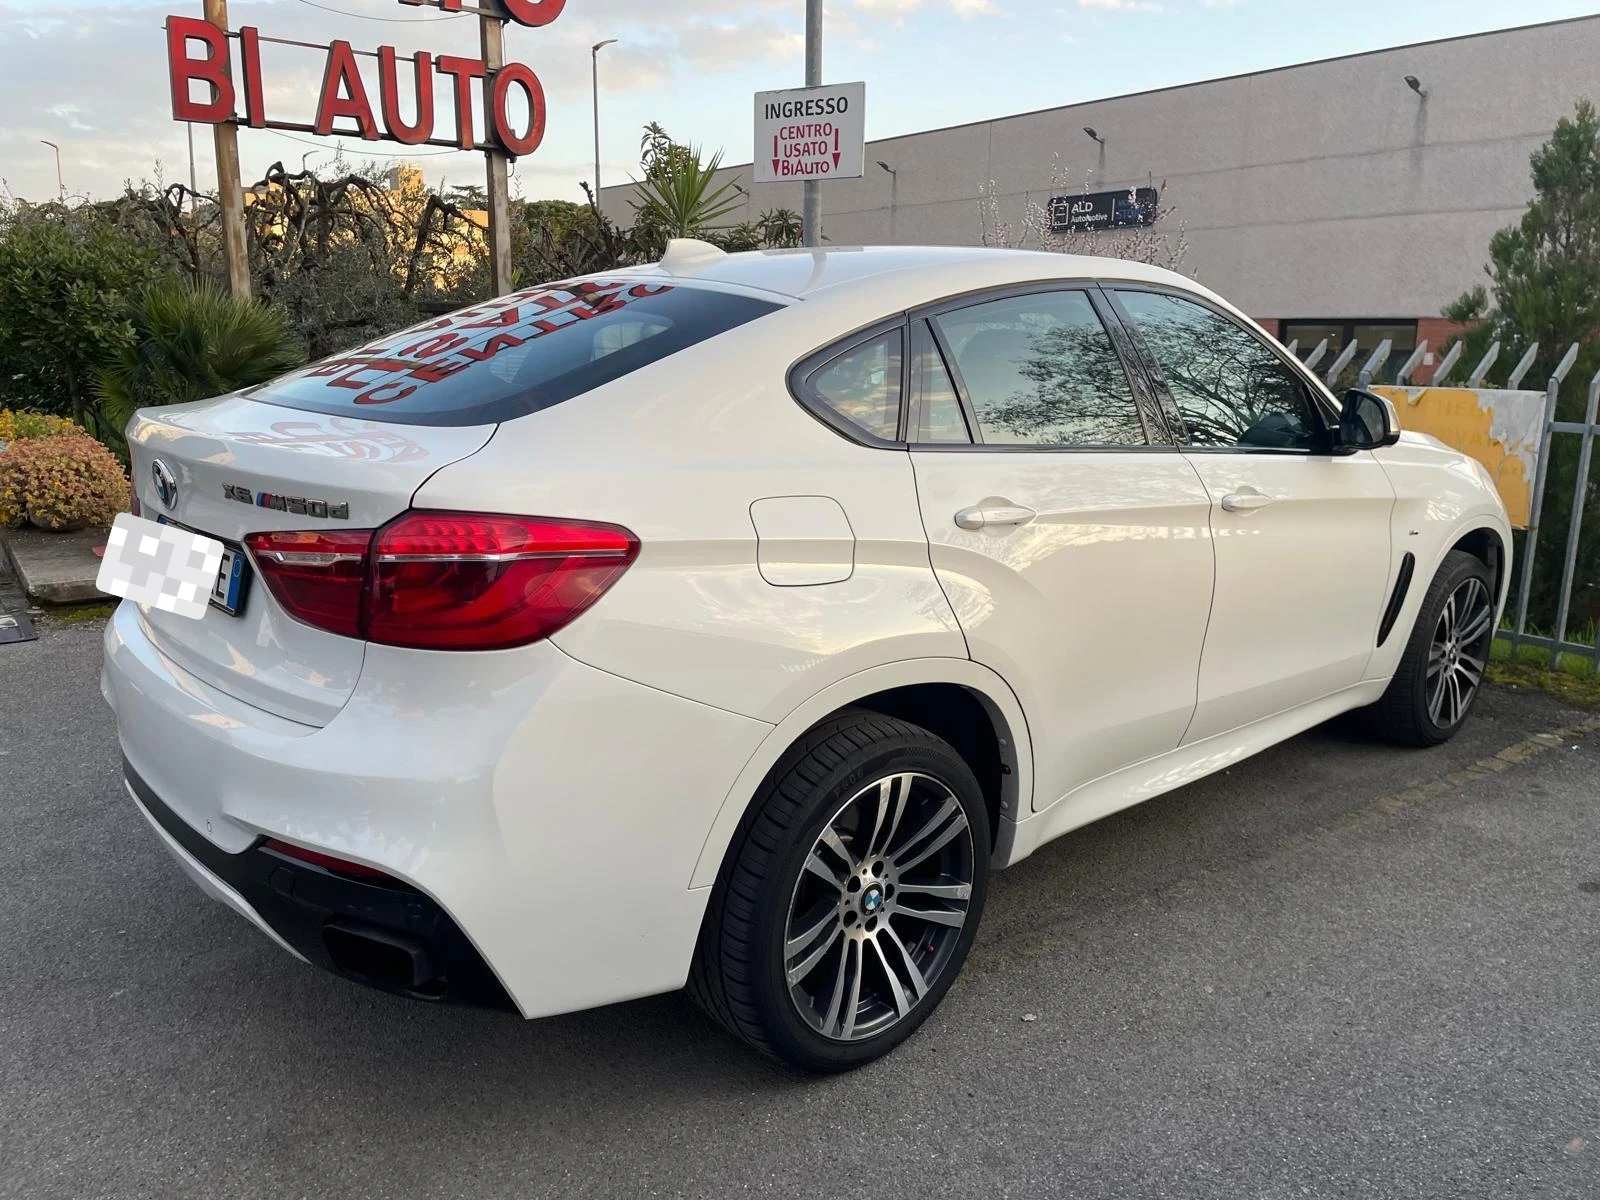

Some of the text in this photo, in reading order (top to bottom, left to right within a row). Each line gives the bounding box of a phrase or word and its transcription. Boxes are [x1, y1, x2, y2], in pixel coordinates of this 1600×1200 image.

[166, 15, 546, 156] BI AUTO
[765, 96, 848, 120] INGRESSO
[779, 122, 832, 141] CENTRO
[783, 141, 828, 158] USATO
[1071, 201, 1094, 214] ALD
[221, 482, 254, 505] X6
